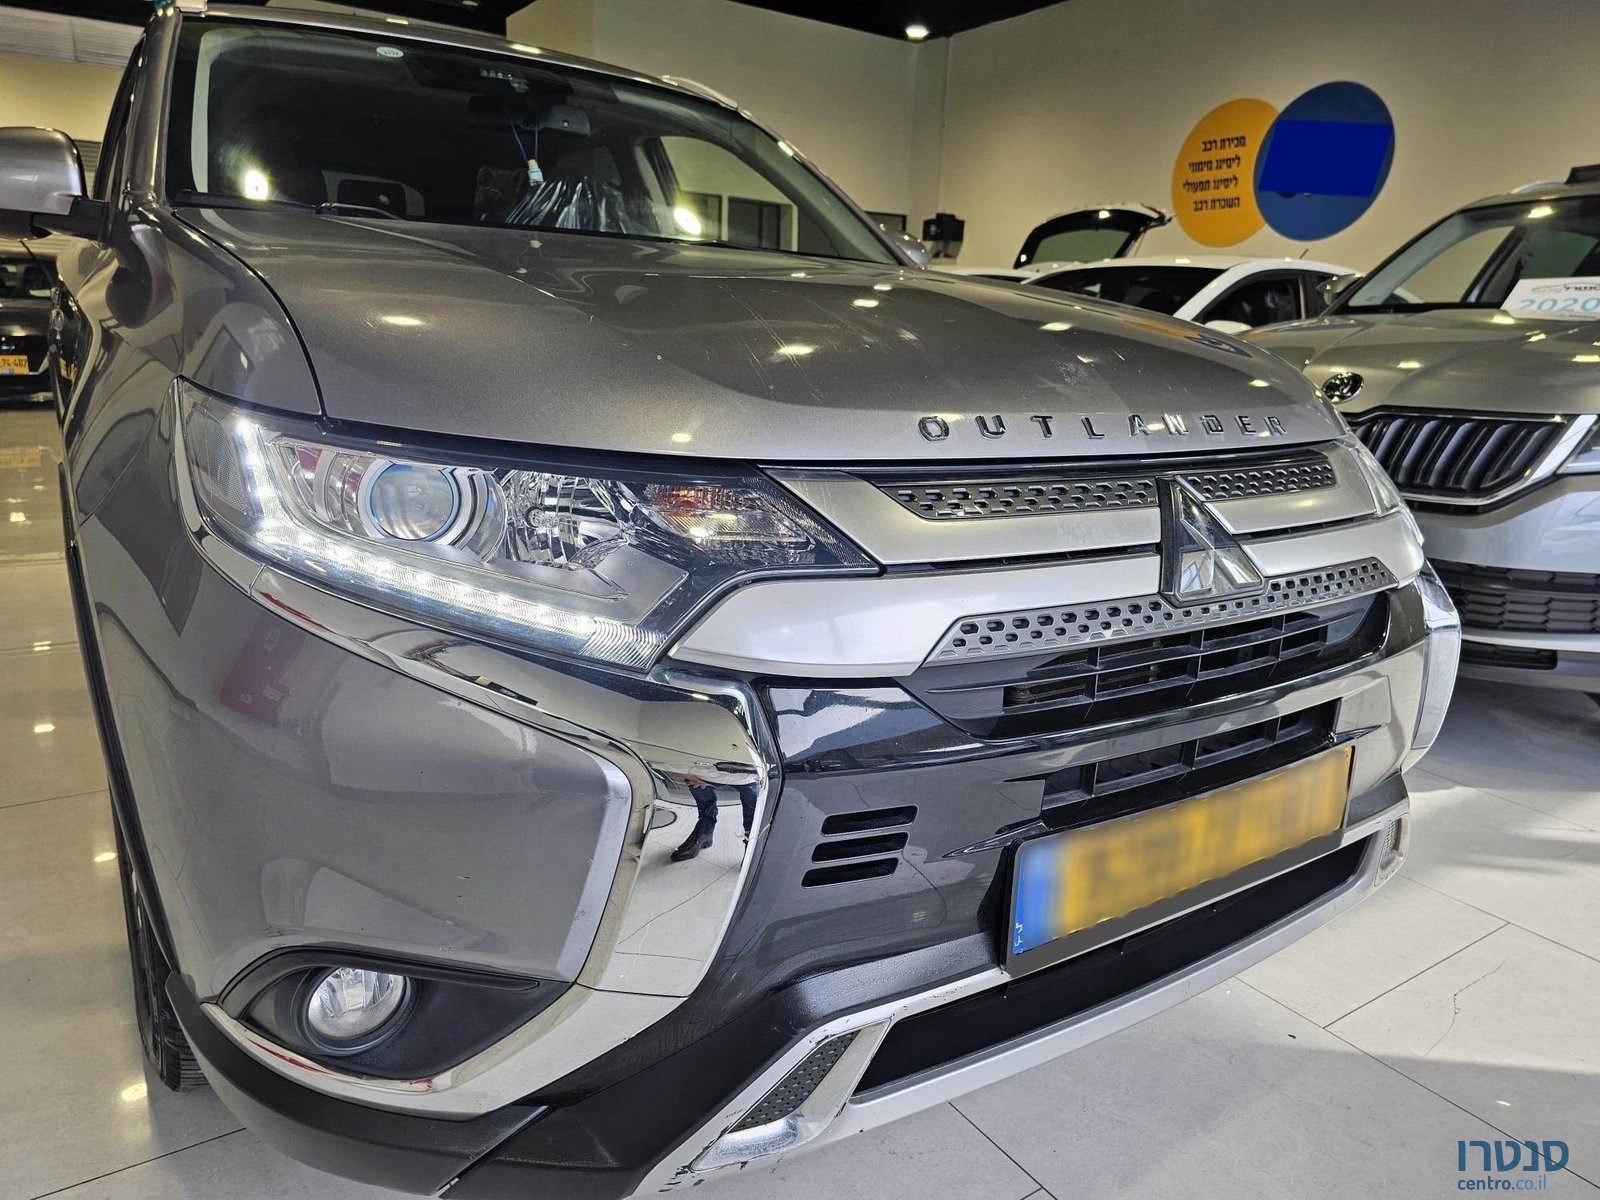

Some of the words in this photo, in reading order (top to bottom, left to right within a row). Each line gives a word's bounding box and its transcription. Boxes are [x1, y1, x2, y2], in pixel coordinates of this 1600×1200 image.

[1201, 139, 1218, 153] רכב
[1219, 135, 1246, 150] מכירת
[1215, 153, 1241, 170] ליסינג
[1182, 179, 1210, 194] תפעולי
[1212, 174, 1238, 190] ליסינג
[1193, 199, 1208, 212] רכב
[1210, 196, 1240, 210] השכרת
[1519, 297, 1600, 313] 2020
[917, 413, 1288, 442] OUTLANDER
